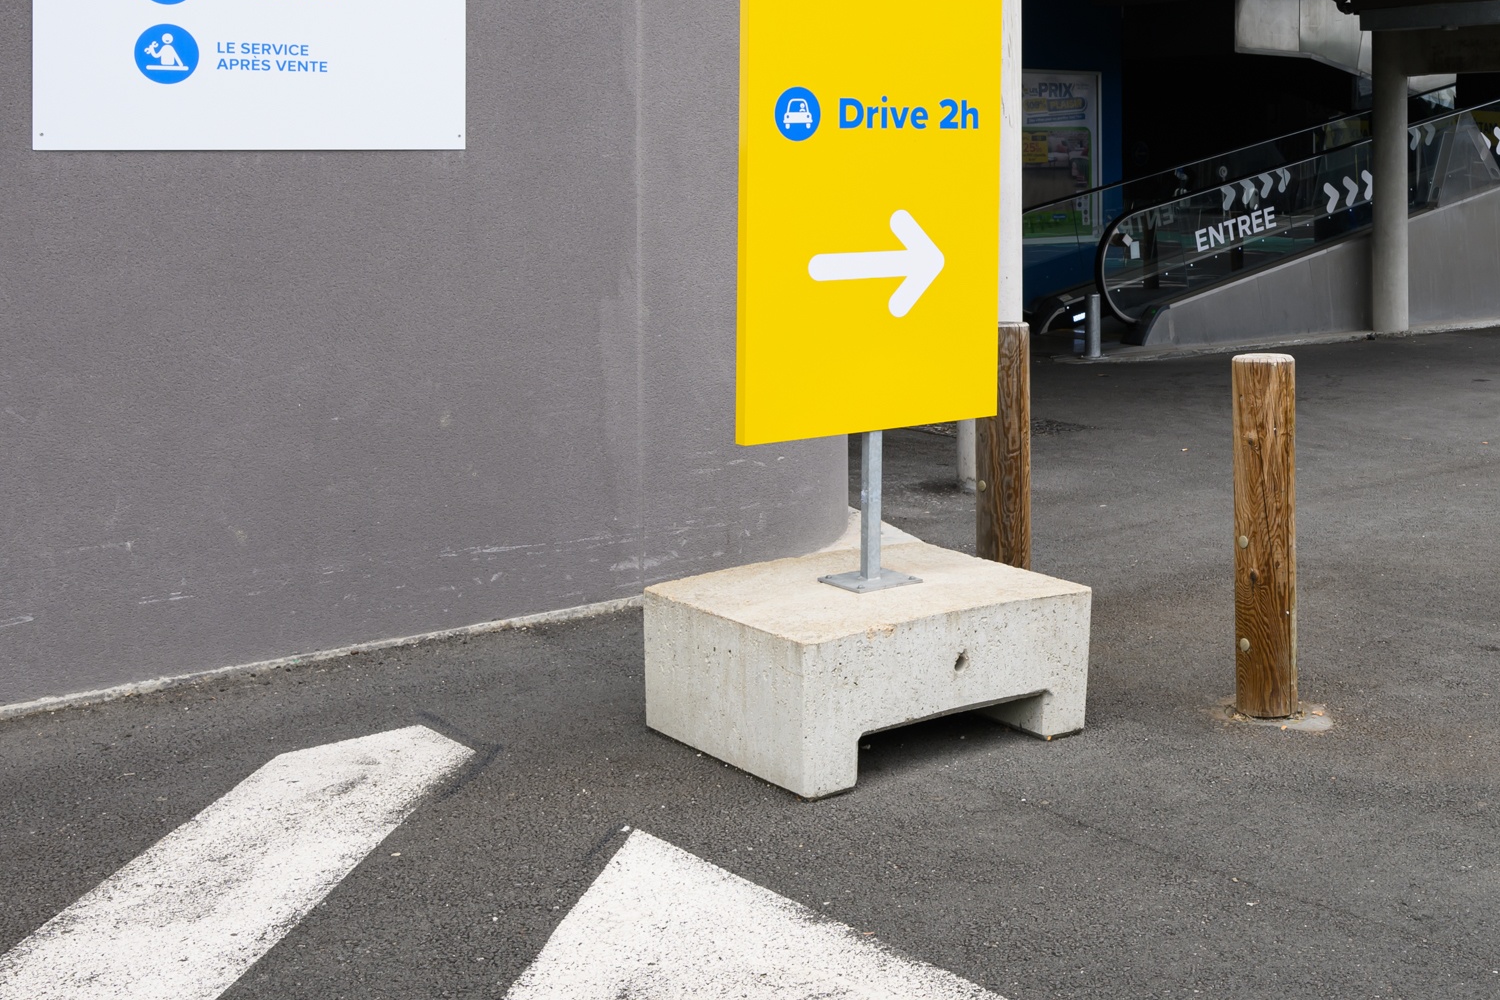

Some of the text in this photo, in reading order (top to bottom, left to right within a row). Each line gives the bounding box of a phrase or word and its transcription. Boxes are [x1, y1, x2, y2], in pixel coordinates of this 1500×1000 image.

[217, 41, 310, 57] LE SERVICE
[216, 55, 328, 73] APRÈS VENTE
[1038, 82, 1074, 98] PRIX
[839, 95, 979, 130] Drive 2h
[1194, 204, 1277, 252] ENTRÉE
